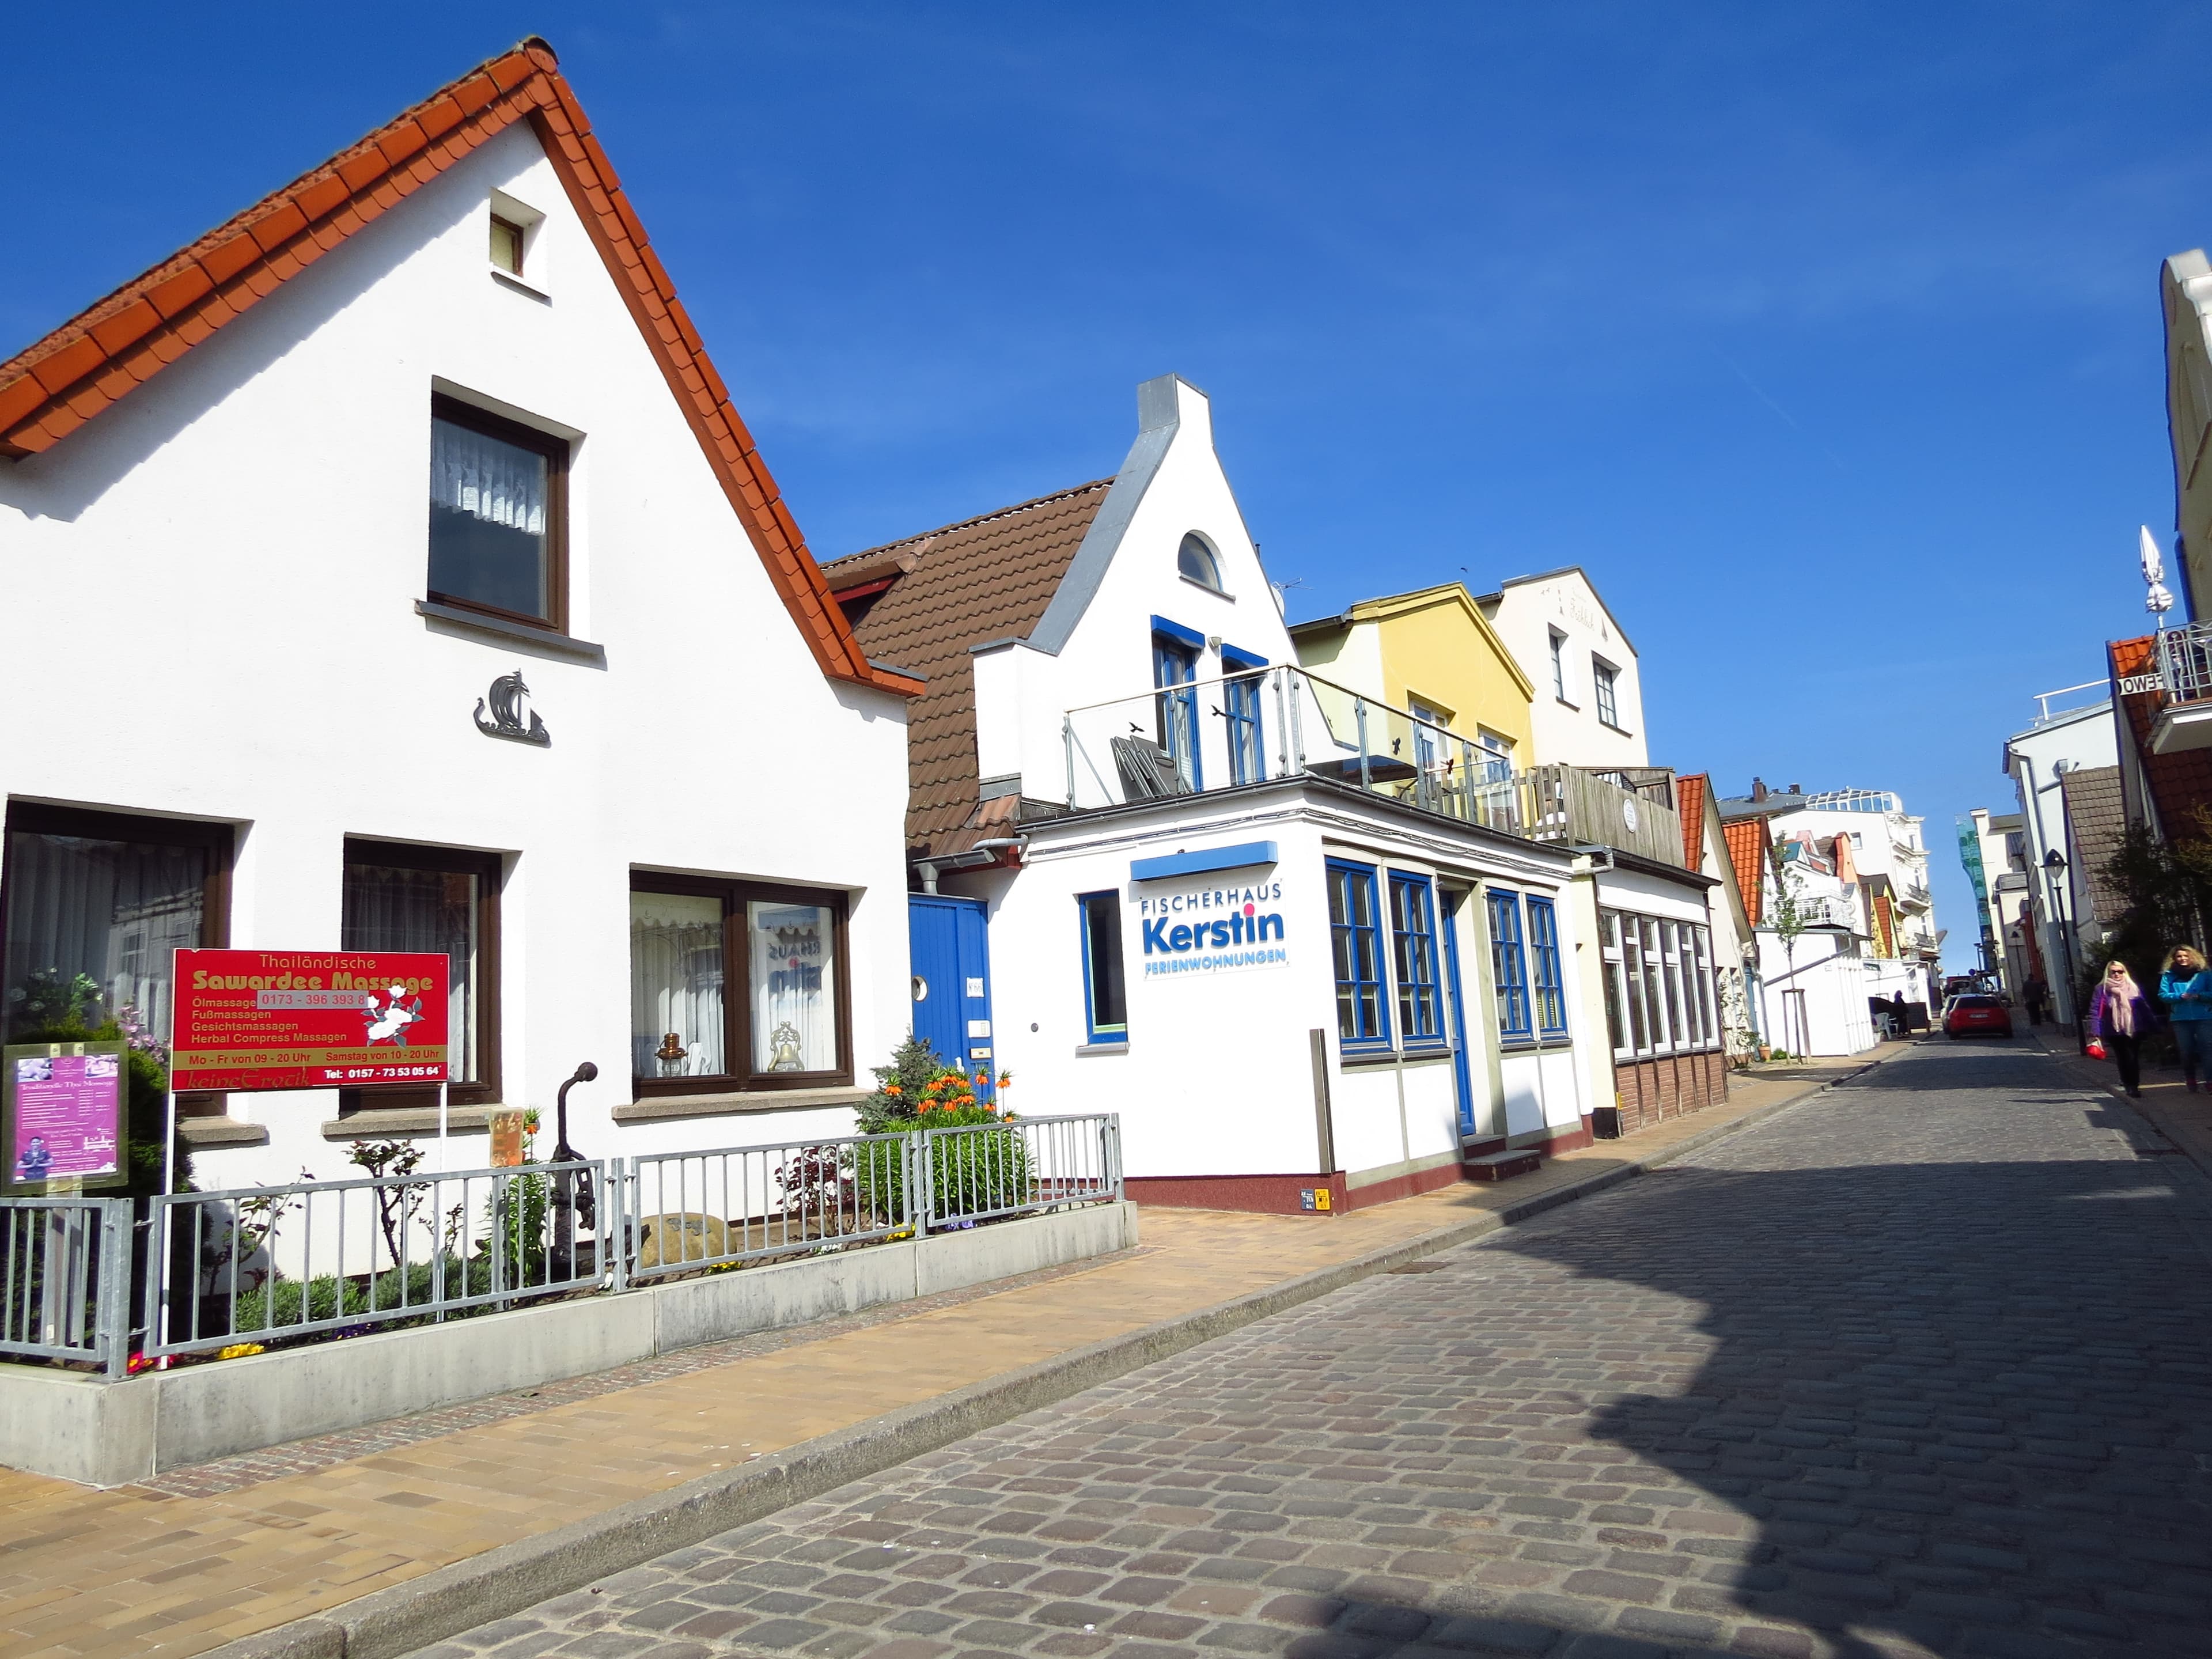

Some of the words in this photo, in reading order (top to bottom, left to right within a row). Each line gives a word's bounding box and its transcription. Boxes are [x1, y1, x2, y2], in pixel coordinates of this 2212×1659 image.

[1141, 883, 1282, 915] FISCHERHAUS
[1142, 903, 1285, 956] Kerstin
[259, 954, 376, 969] Thailändische
[1145, 948, 1286, 975] FERIENWOHNUNGEN
[192, 970, 323, 990] Sawardee
[331, 972, 433, 995] Massage
[262, 994, 293, 1005] 0173
[305, 994, 327, 1005] 396
[332, 994, 354, 1005] 393
[358, 994, 365, 1005] 8
[192, 1010, 271, 1021] Fußmassagen
[191, 1022, 298, 1032] Gesichtsmassagen
[191, 1034, 229, 1044] Herbal
[233, 1033, 290, 1044] Compress
[293, 1032, 347, 1043] Massagen
[189, 1055, 206, 1065] Mo
[217, 1055, 229, 1064] Fr
[232, 1056, 251, 1064] von
[254, 1054, 267, 1063] 09
[276, 1054, 290, 1063] 20
[293, 1052, 312, 1062] Uhr
[325, 1052, 368, 1062] Samstag
[391, 1051, 402, 1059] 10
[410, 1051, 421, 1059] 20
[423, 1050, 440, 1059] Uhr
[324, 1070, 343, 1079] Tel:
[348, 1069, 374, 1078] 0157
[382, 1068, 396, 1077] 73
[397, 1067, 410, 1077] 53
[412, 1067, 426, 1076] 05
[426, 1066, 439, 1075] 64
